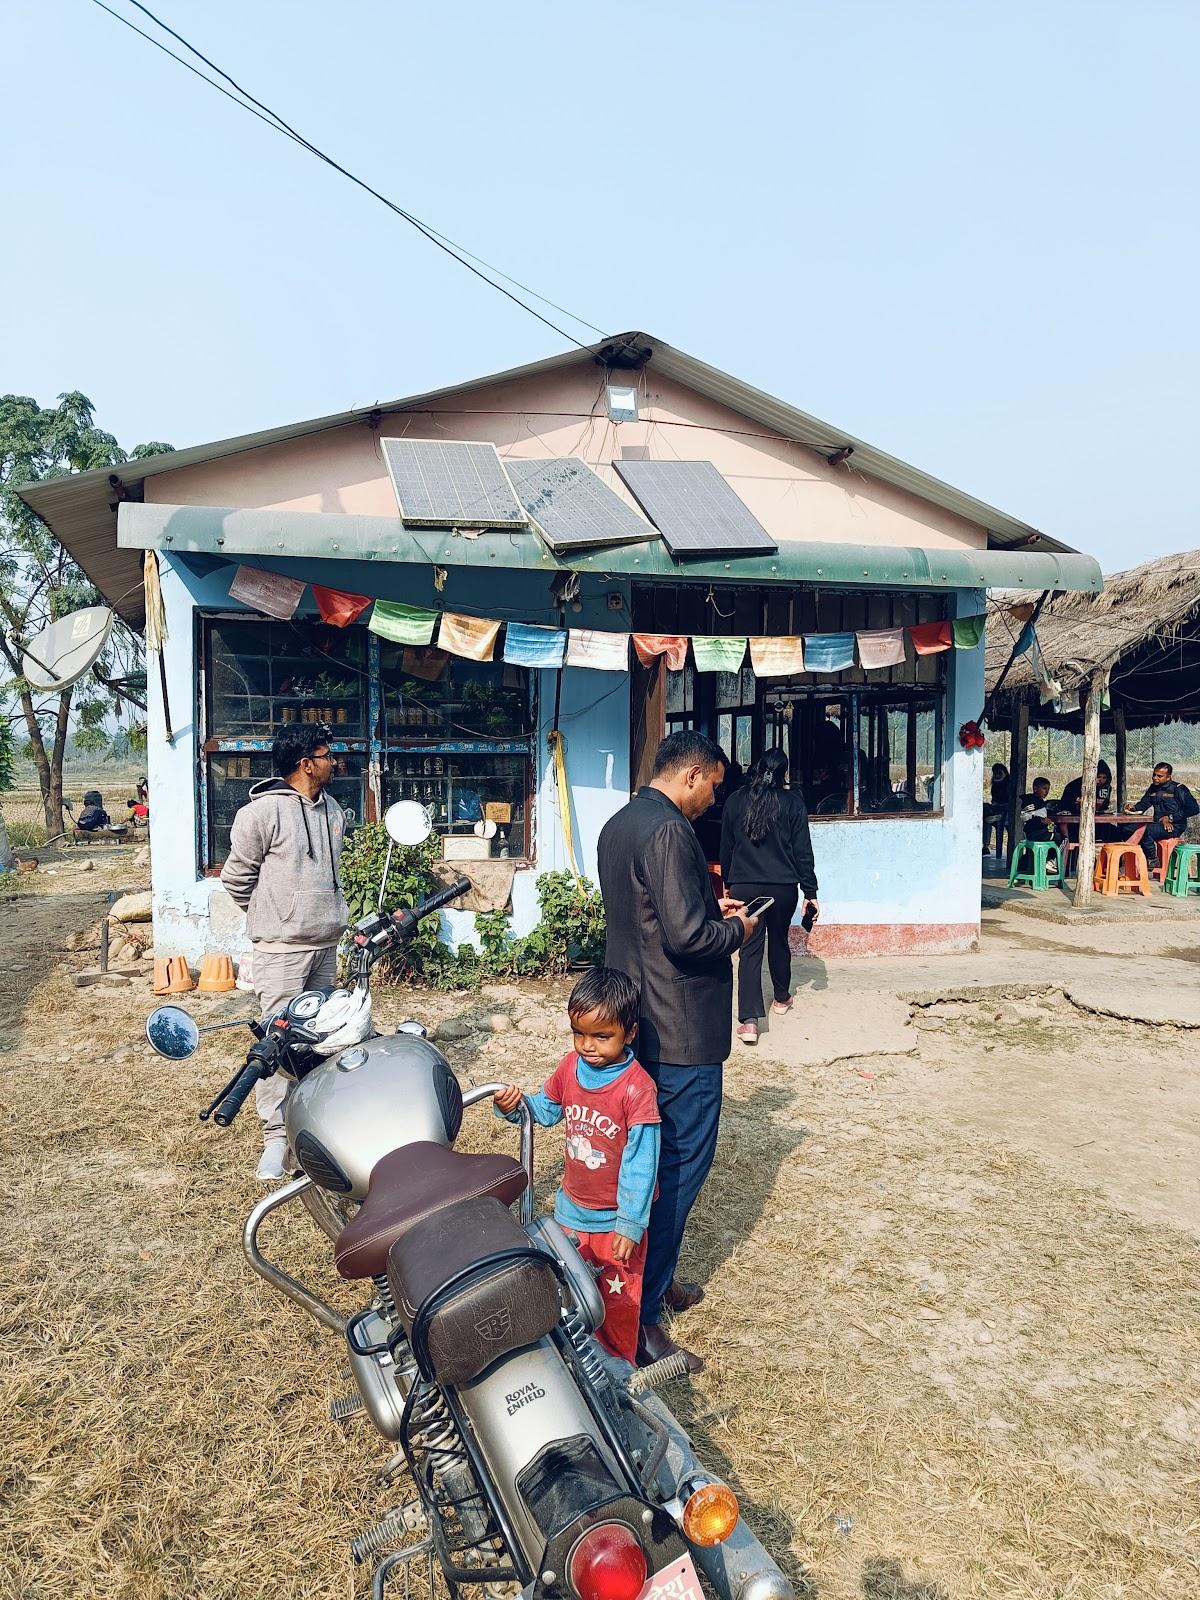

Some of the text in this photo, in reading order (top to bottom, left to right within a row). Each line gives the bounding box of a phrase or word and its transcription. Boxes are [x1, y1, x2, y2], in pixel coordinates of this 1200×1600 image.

[564, 1104, 621, 1139] POLICE
[505, 1382, 538, 1404] ROYAL
[506, 1388, 546, 1416] ENFIELD
